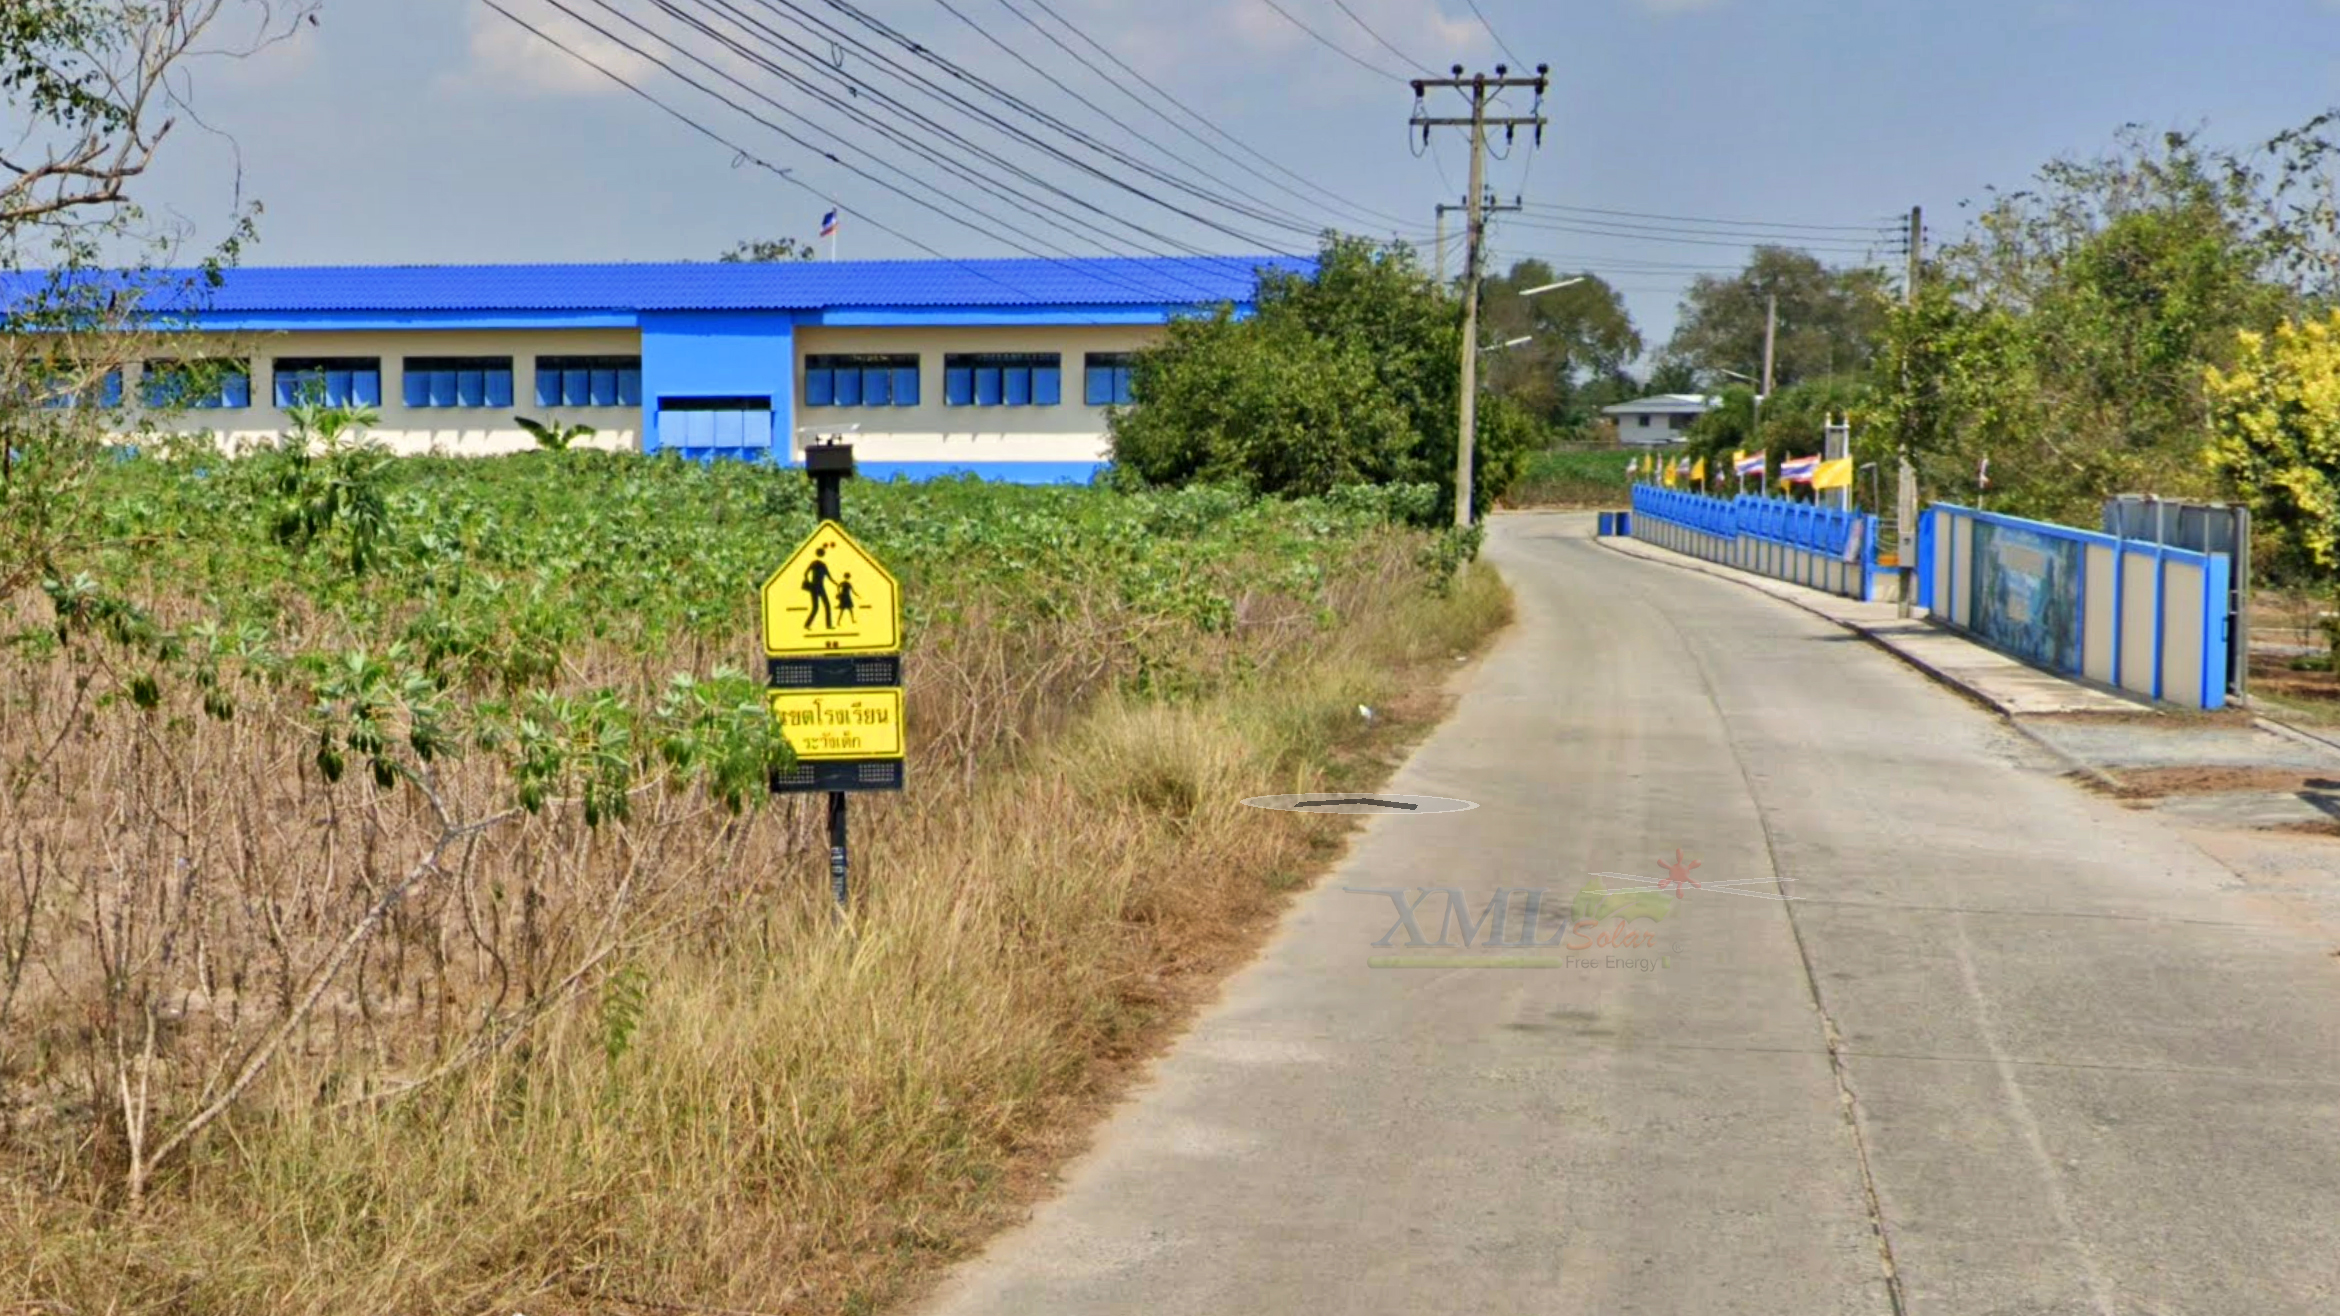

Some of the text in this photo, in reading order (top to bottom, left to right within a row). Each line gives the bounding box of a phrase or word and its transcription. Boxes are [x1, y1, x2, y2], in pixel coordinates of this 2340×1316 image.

[780, 698, 889, 726] เขตโรงเรียน
[803, 730, 861, 749] ระวังเด็ก
